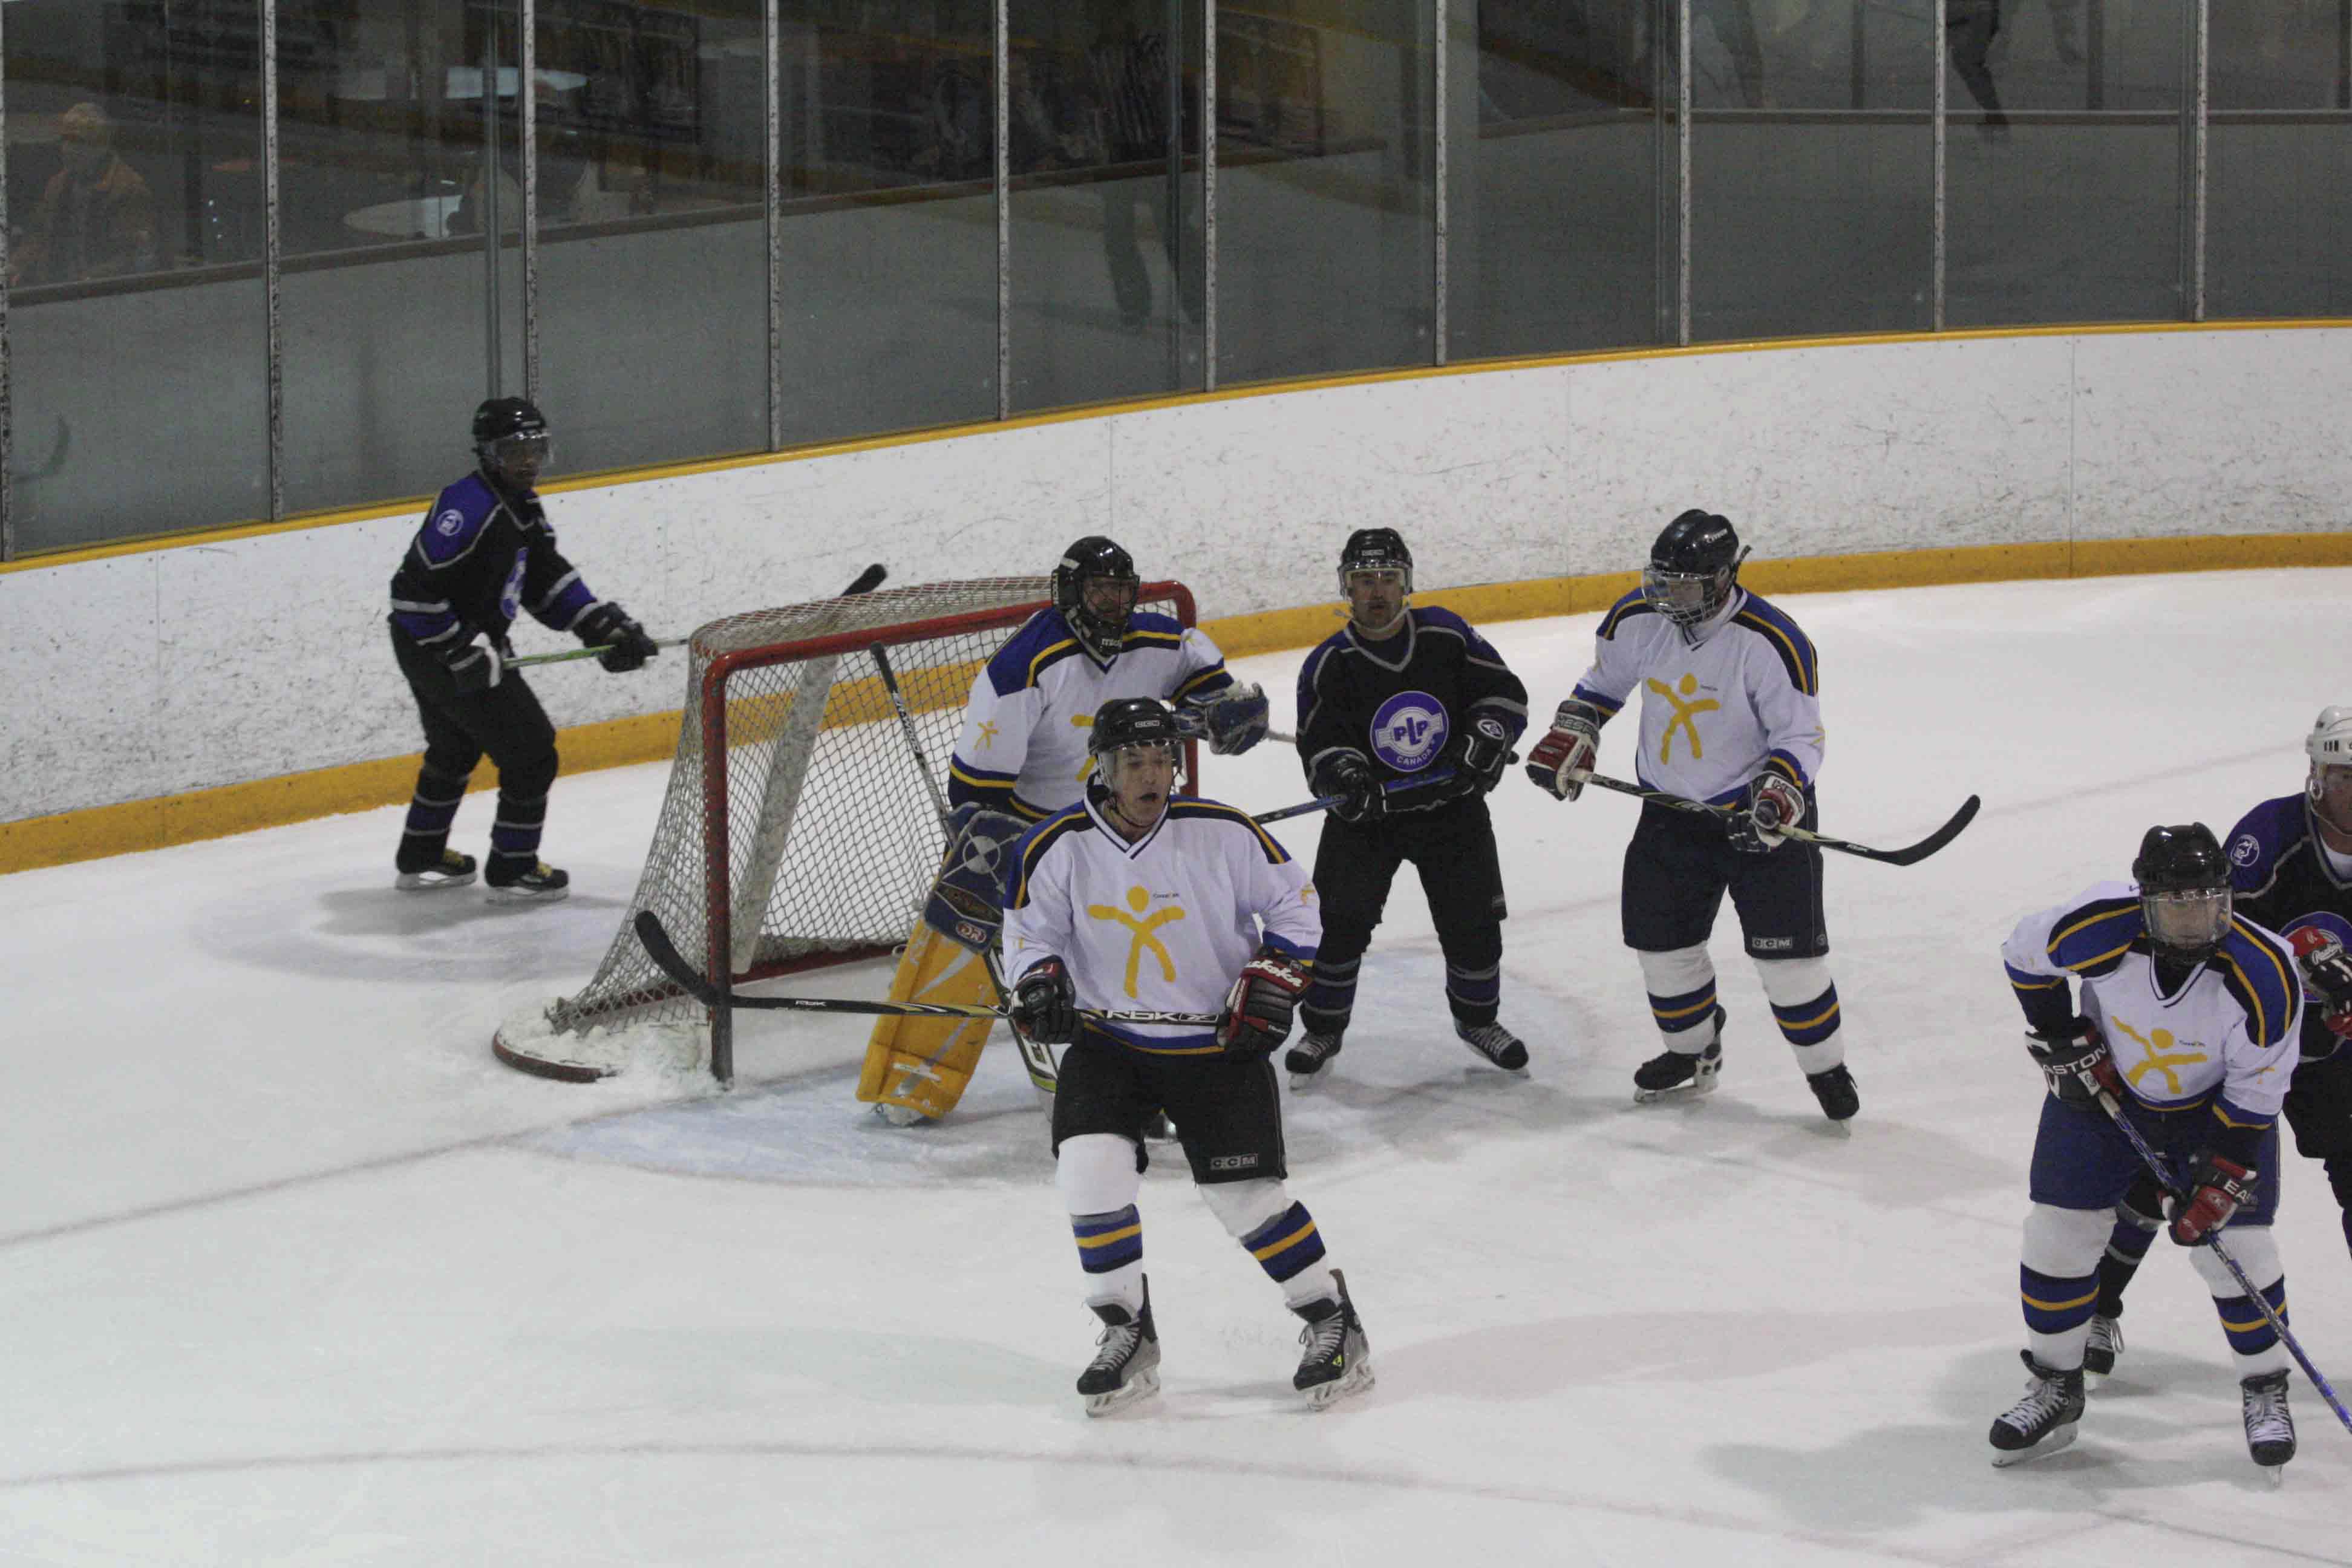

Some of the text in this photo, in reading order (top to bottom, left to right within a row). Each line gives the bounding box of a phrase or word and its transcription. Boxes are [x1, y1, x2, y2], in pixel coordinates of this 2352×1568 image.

[1394, 717, 1428, 745] PLP
[1752, 938, 1792, 949] CCM
[2042, 1043, 2108, 1075] ASTON
[1212, 1155, 1256, 1168] CCM
